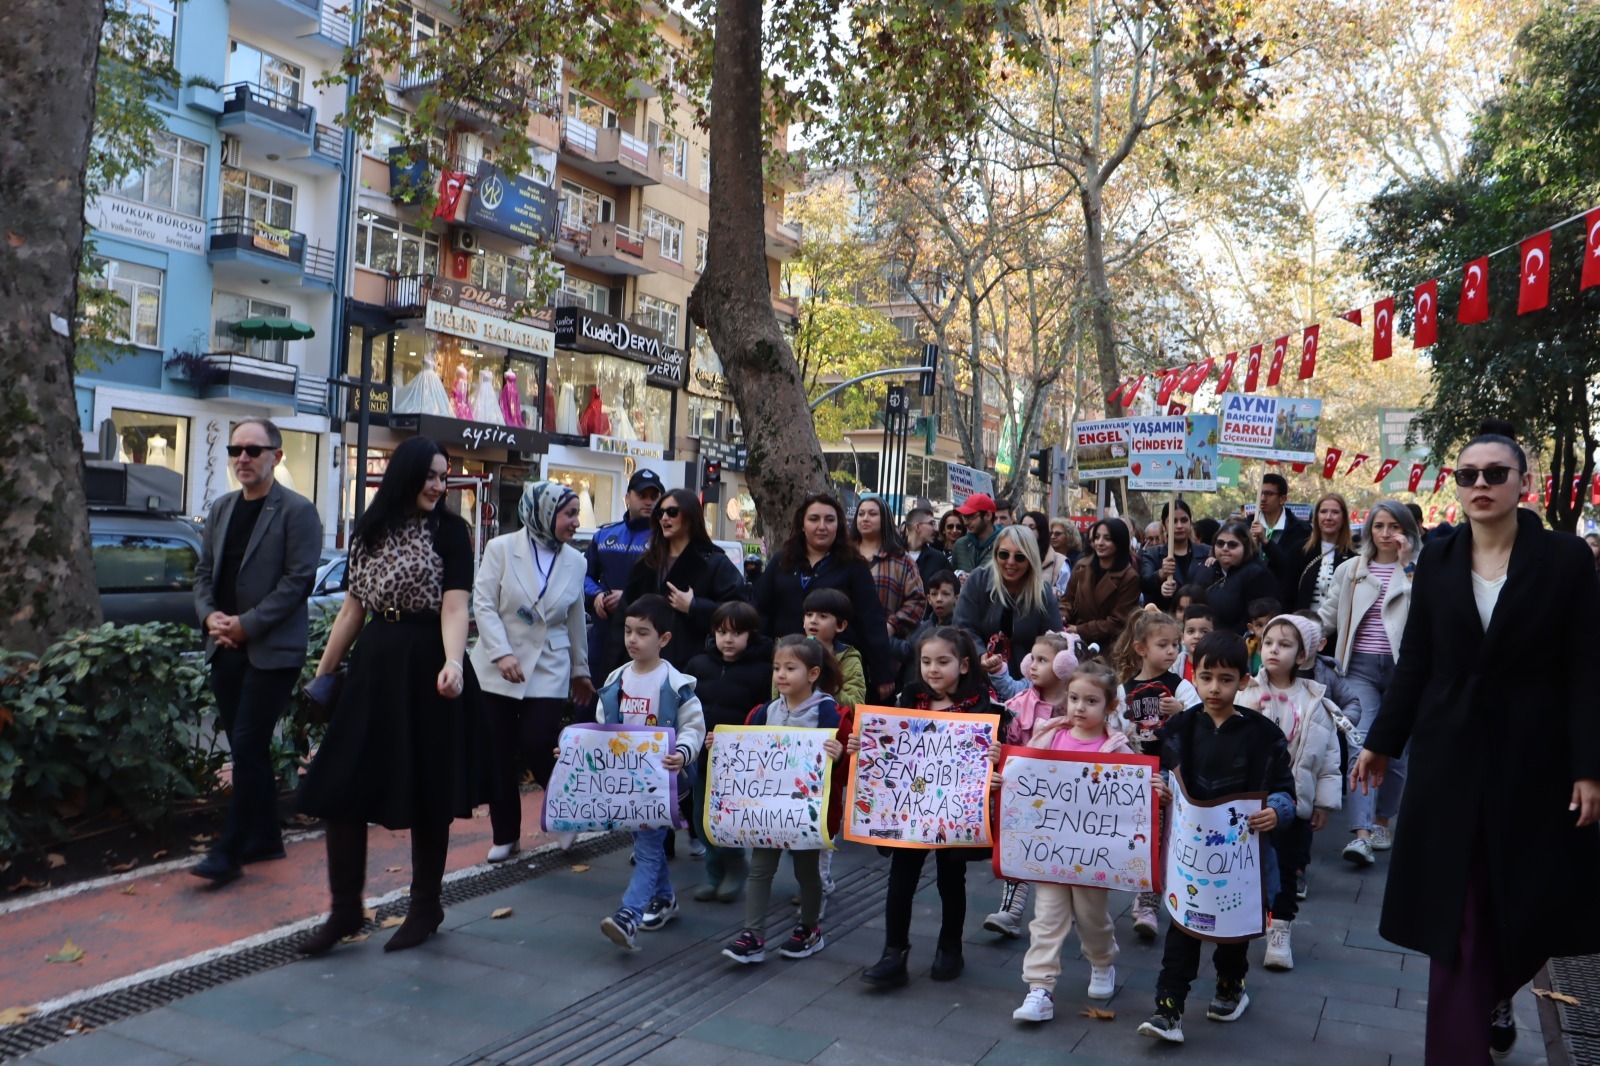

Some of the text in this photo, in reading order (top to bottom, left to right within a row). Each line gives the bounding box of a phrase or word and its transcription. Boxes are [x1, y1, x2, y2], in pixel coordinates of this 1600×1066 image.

[112, 203, 202, 234] HUKUK BÜROSU
[459, 285, 508, 310] Dilek
[484, 322, 551, 353] KARAHAN
[613, 322, 661, 357] DERYA
[1228, 396, 1276, 414] AYNI
[1077, 423, 1100, 432] HAYATI
[1132, 421, 1185, 437] YAŞAMIN
[1224, 422, 1273, 437] FARKLI
[1226, 412, 1274, 424] BAHÇENİN
[1078, 432, 1123, 445] ENGEL
[1131, 436, 1183, 453] İÇİNDEYİZ
[1223, 434, 1271, 445] ÇİÇEKLERİYİZ
[896, 731, 953, 758] BANA
[559, 745, 657, 771] EN BÜYÜK
[871, 757, 918, 782] SEN
[572, 774, 643, 795] ENGEL
[721, 778, 791, 798] ENGEL
[1087, 782, 1146, 807] VARSA
[891, 789, 964, 824] YAKLAŞ
[729, 808, 808, 829] TANIMAZ
[1034, 808, 1128, 838] ENGEL
[1206, 844, 1255, 875] OLMA
